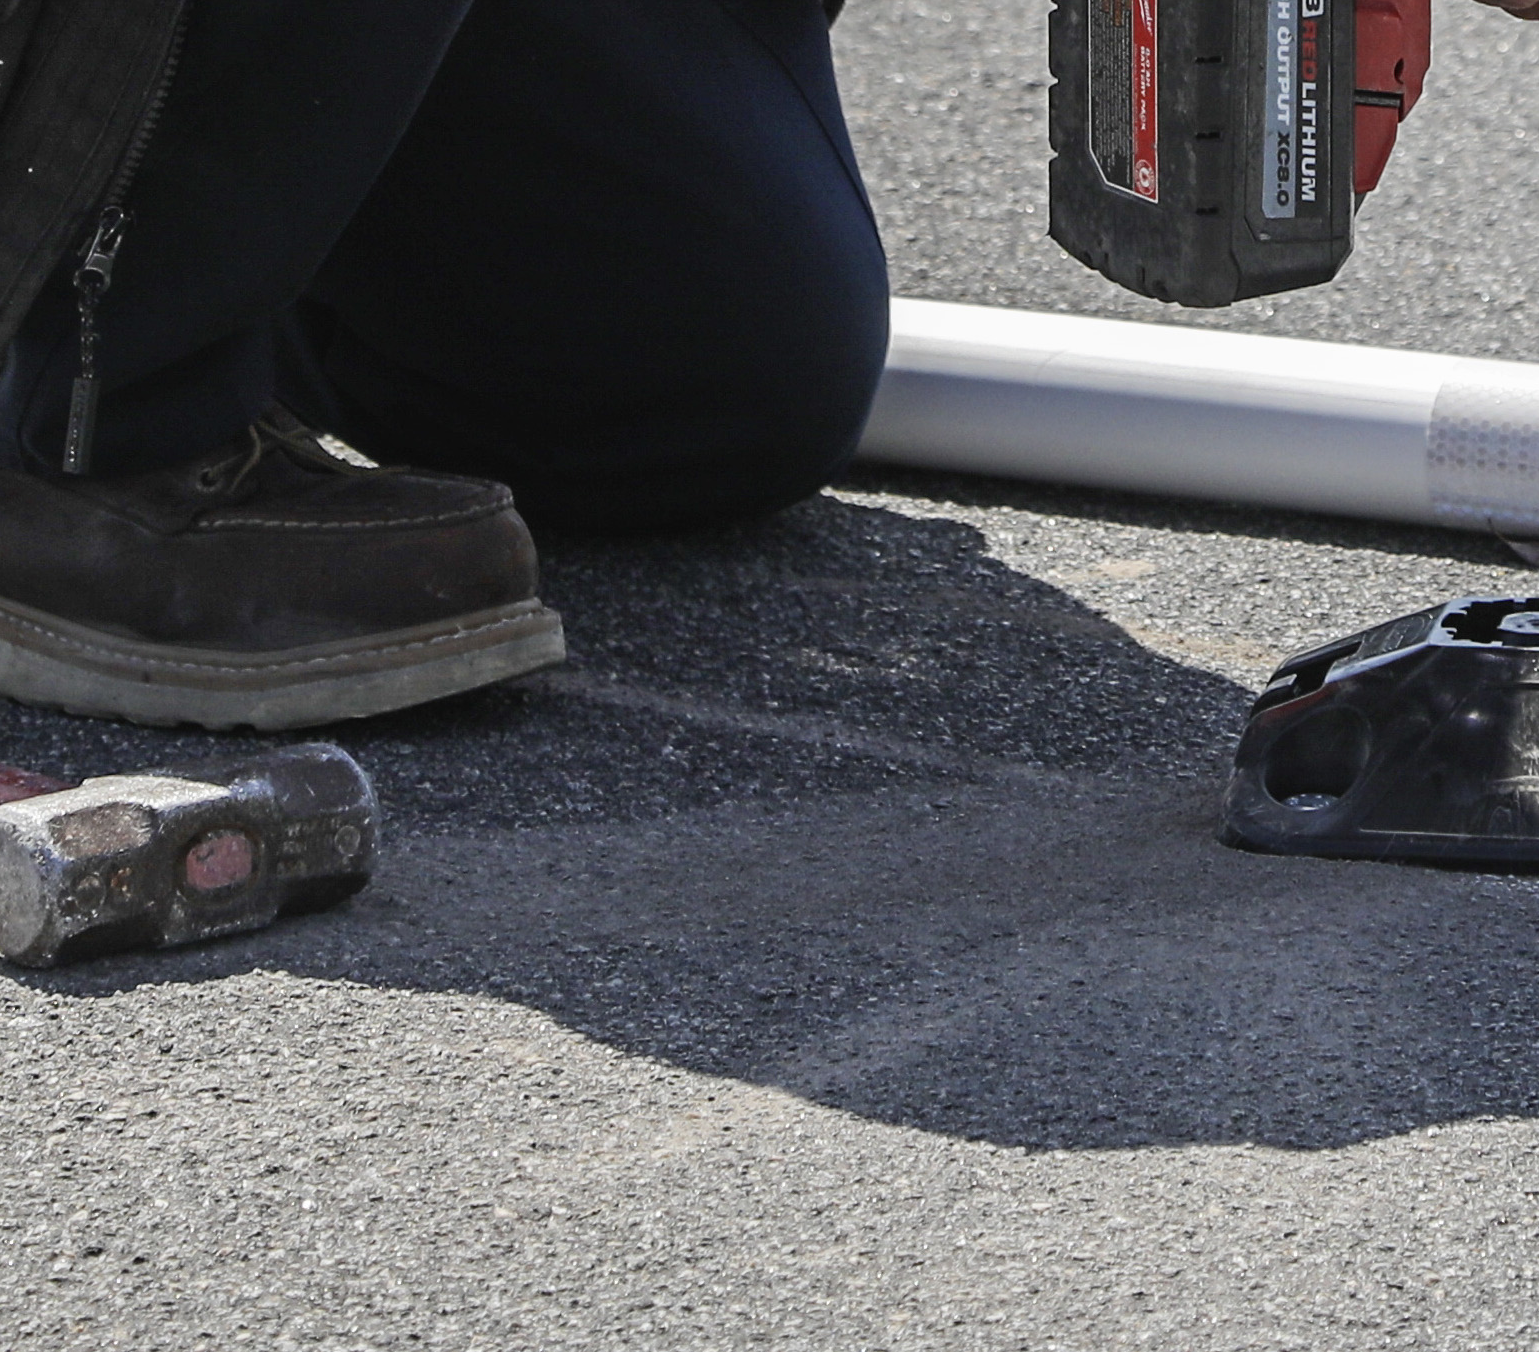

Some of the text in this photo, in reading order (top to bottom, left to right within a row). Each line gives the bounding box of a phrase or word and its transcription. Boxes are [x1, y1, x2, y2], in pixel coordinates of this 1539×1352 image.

[1139, 46, 1147, 131] BATTERY PACK
[1277, 26, 1292, 126] OUTPUT
[1301, 21, 1318, 202] REDLITHIUM
[1277, 131, 1291, 207] XC8.0
